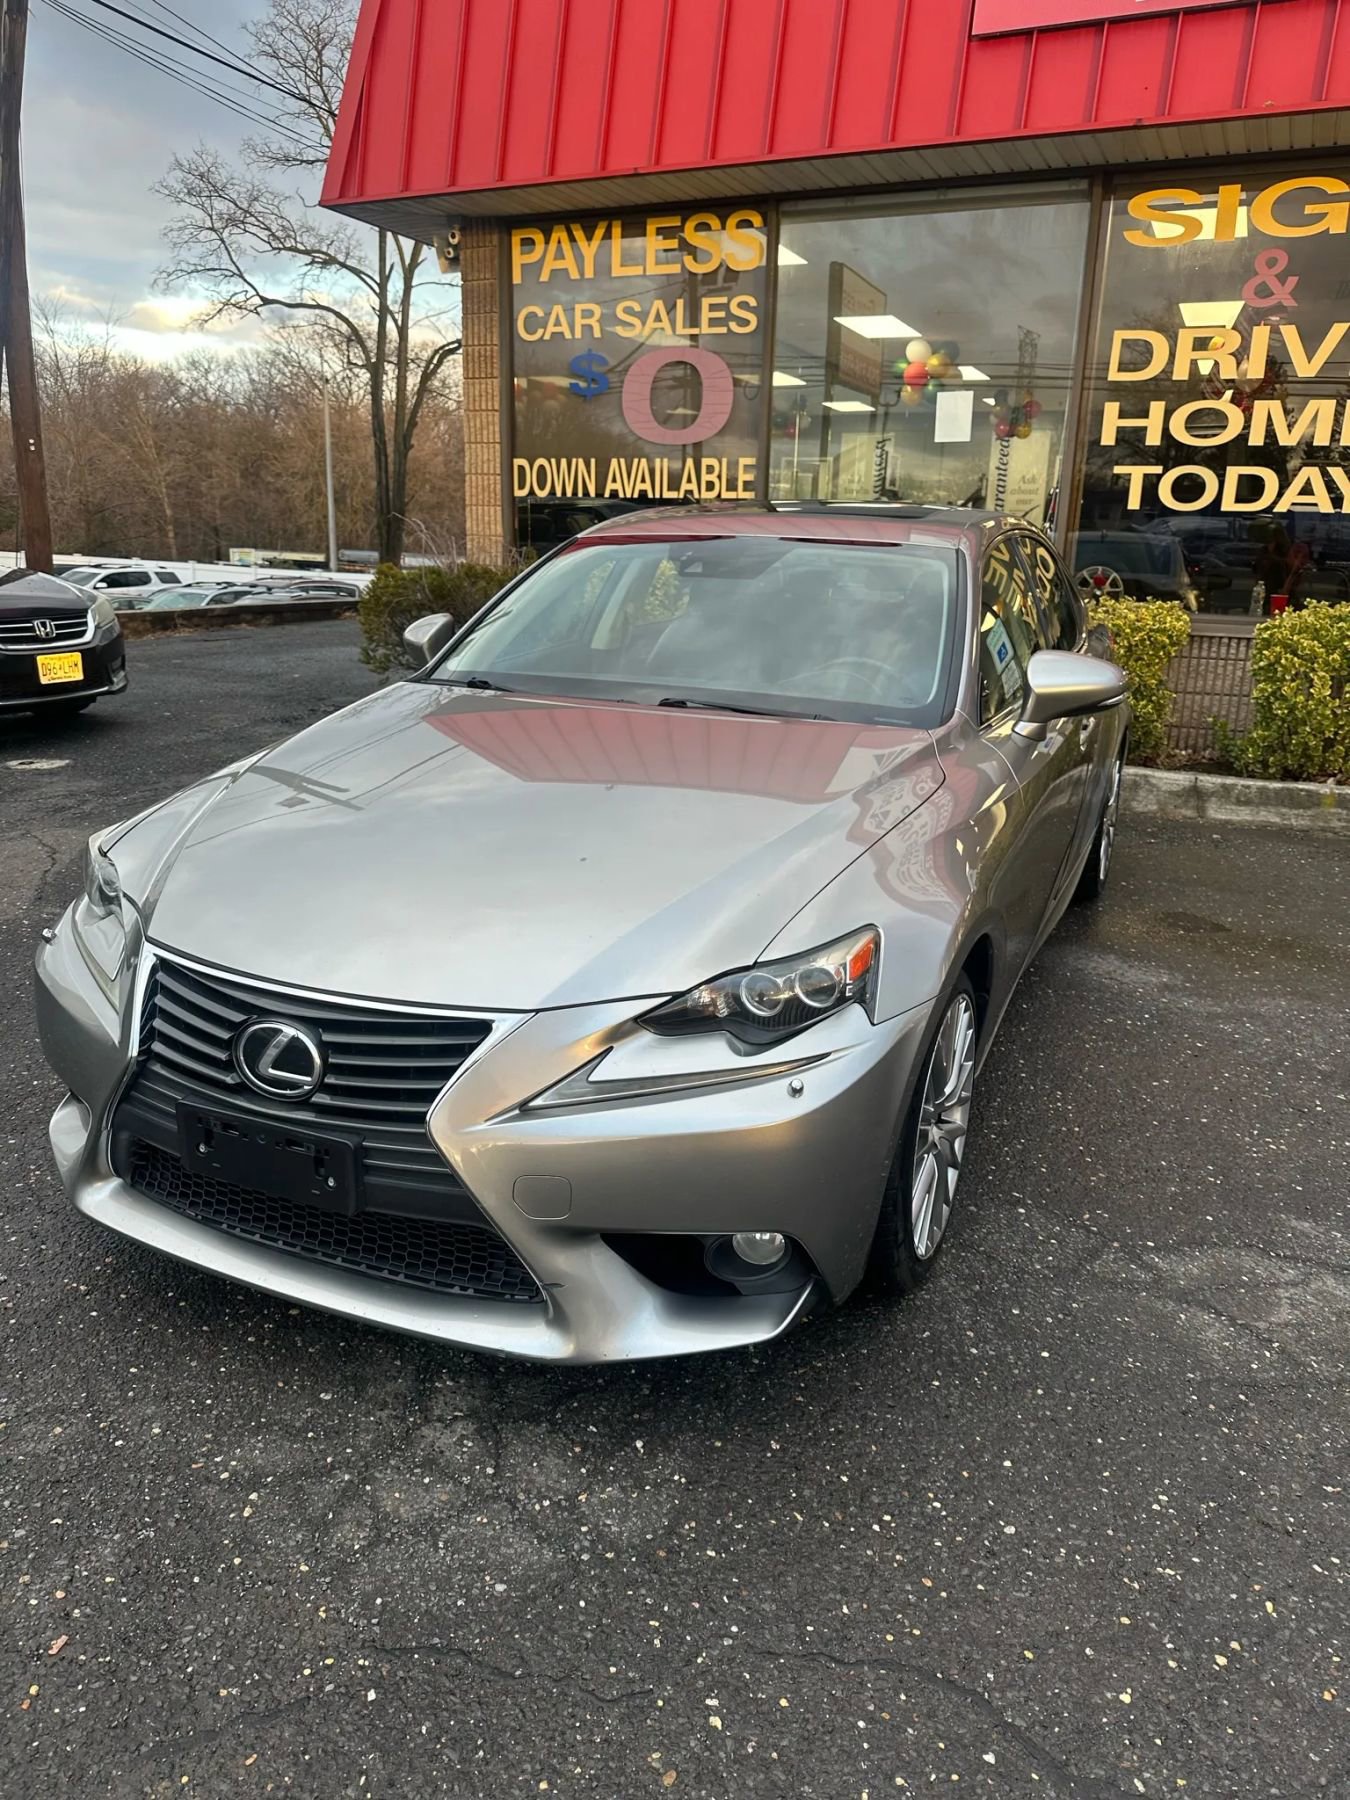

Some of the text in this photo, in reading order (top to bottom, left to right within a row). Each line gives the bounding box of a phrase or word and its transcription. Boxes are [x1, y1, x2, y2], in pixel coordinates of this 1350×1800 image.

[511, 210, 764, 284] PAYLESS
[1241, 248, 1299, 308] &
[517, 295, 758, 341] CAR SALES
[1107, 322, 1350, 382] DRIV
[1100, 399, 1350, 447] HOM
[513, 457, 756, 500] DOWN AVAILABLE
